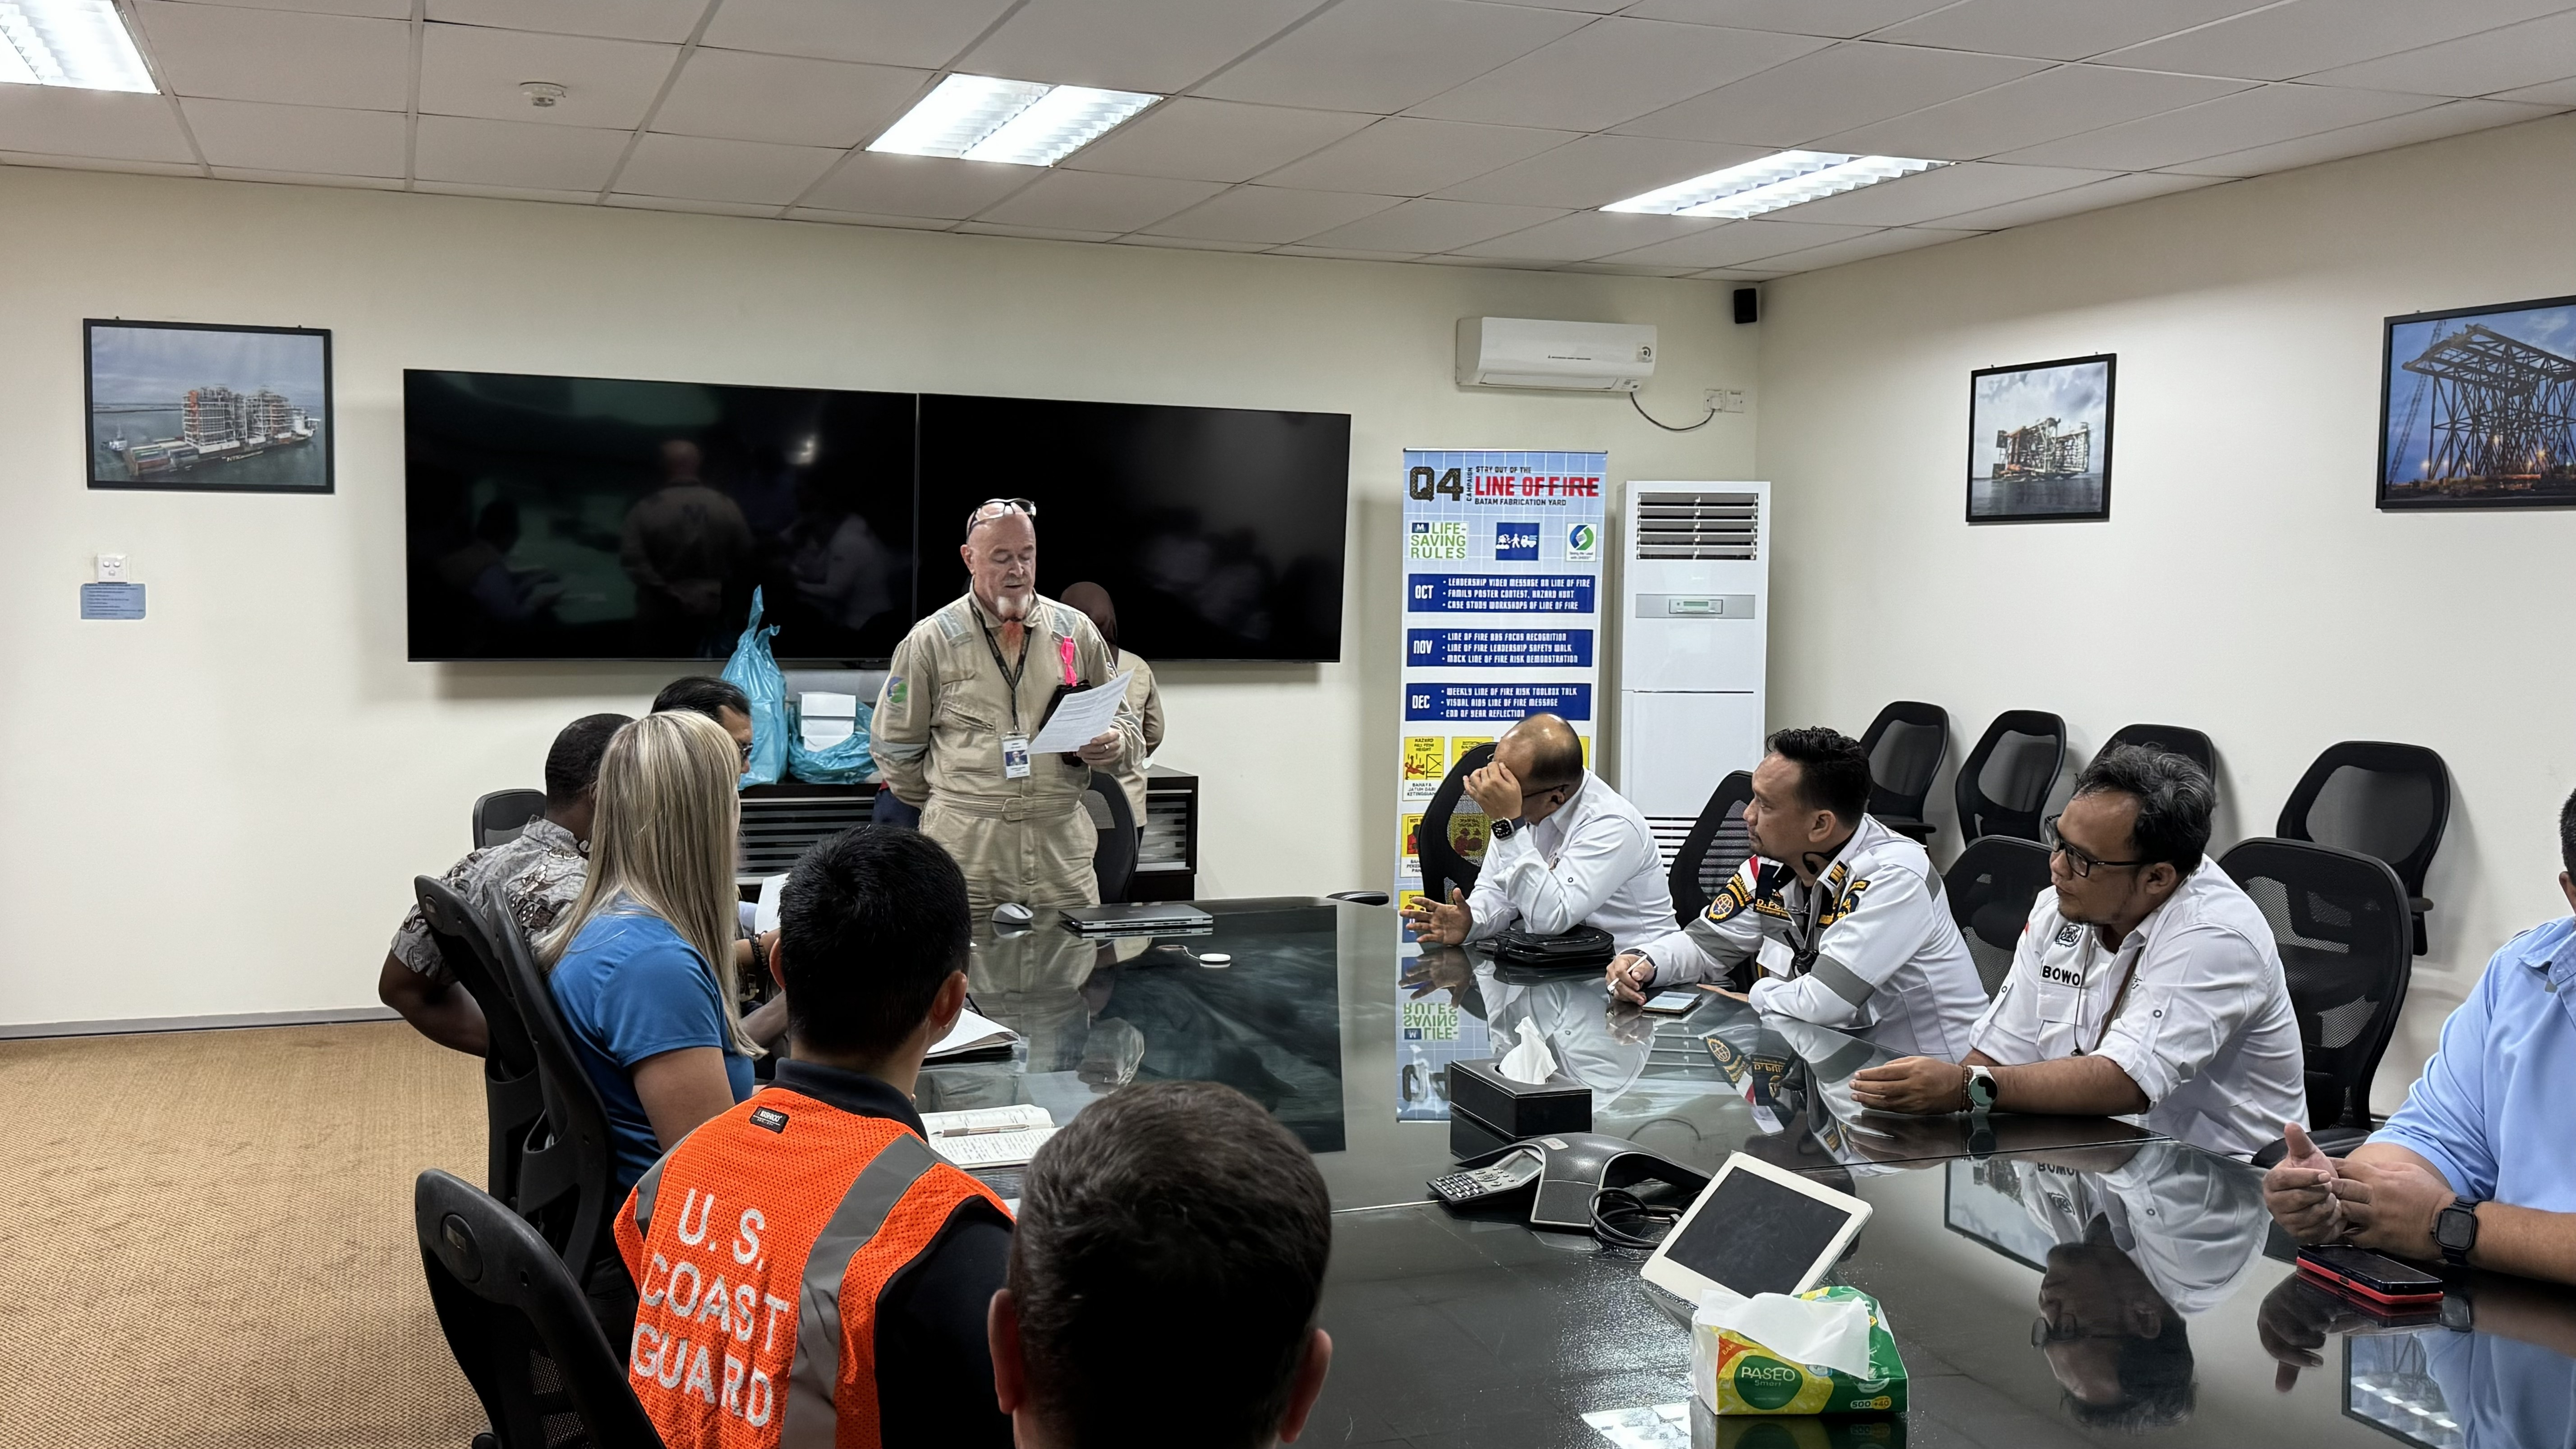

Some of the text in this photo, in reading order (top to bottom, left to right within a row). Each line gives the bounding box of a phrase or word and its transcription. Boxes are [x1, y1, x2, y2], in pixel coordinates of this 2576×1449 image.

[1410, 466, 1464, 502] Q4
[1475, 476, 1600, 497] LINE OF FIRE
[1432, 522, 1466, 534] LIFE-
[1411, 535, 1466, 546] SAVING
[1411, 547, 1466, 559] RULES
[1448, 578, 1487, 586] LEADERSHIP
[1489, 579, 1507, 587] VIDEO
[1509, 579, 1538, 587] MESSAGE
[1551, 579, 1564, 587] LINE
[1566, 579, 1574, 587] OF
[1576, 579, 1590, 588] FIRE
[1415, 585, 1434, 599] OCT
[1448, 589, 1472, 598] FAMILY
[1474, 589, 1499, 598] POSTER
[1448, 601, 1578, 610] CASE STUDY WORKSHOPS OF LINE OF FIRE
[1448, 633, 1462, 641] LINE
[1464, 633, 1472, 641] OF
[1474, 633, 1488, 641] FIRE
[1504, 633, 1524, 641] FOCUS
[1526, 633, 1566, 641] RECOGNITION
[1413, 640, 1433, 654] NOV
[1447, 644, 1572, 652] LINE OF FIRE LEADERSHIP SAFETY WALK
[1447, 654, 1578, 663] MOCK LINE OF FIRE RISK DEMONSTRATION
[1446, 688, 1472, 696] WEEKLY
[1474, 688, 1488, 696] LINE
[1490, 688, 1498, 696] OF
[1561, 687, 1577, 695] TALK
[1412, 695, 1430, 709] DEC
[1446, 698, 1558, 707] VISUAL AIDS LINE OF FIRE MESSAGE
[1446, 709, 1525, 718] END OF YEAR REFLECTION
[2042, 965, 2080, 986] BOWO
[677, 1188, 766, 1272] U. S.
[641, 1253, 790, 1352] COAST
[631, 1323, 773, 1428] GUARD
[1741, 1366, 1796, 1382] PASEO
